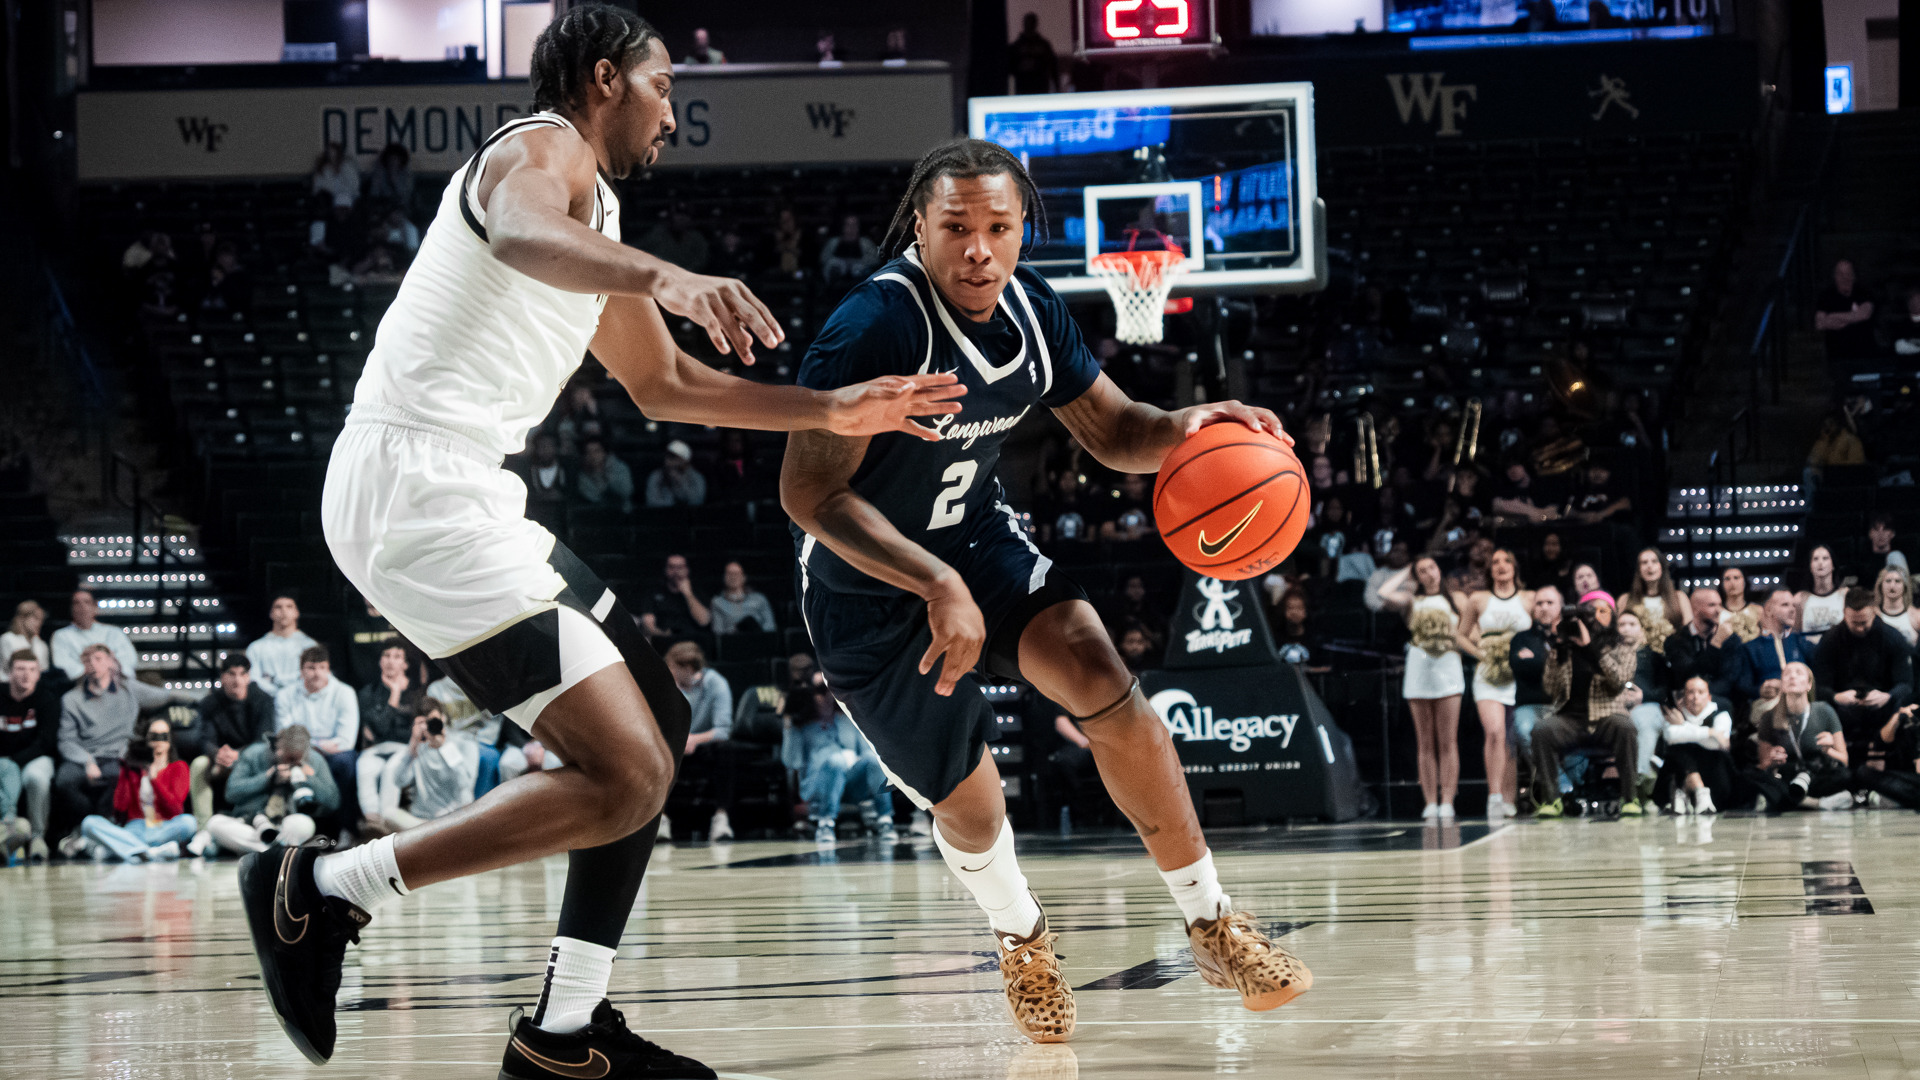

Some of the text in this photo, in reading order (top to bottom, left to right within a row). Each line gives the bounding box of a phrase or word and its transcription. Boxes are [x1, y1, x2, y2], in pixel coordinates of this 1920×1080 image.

[806, 102, 855, 138] WF
[1385, 72, 1477, 136] WF
[176, 116, 229, 152] WF
[323, 106, 482, 153] DEMON
[925, 404, 1031, 450] Longwood
[926, 459, 978, 530] 2
[1168, 705, 1299, 752] Allegacy
